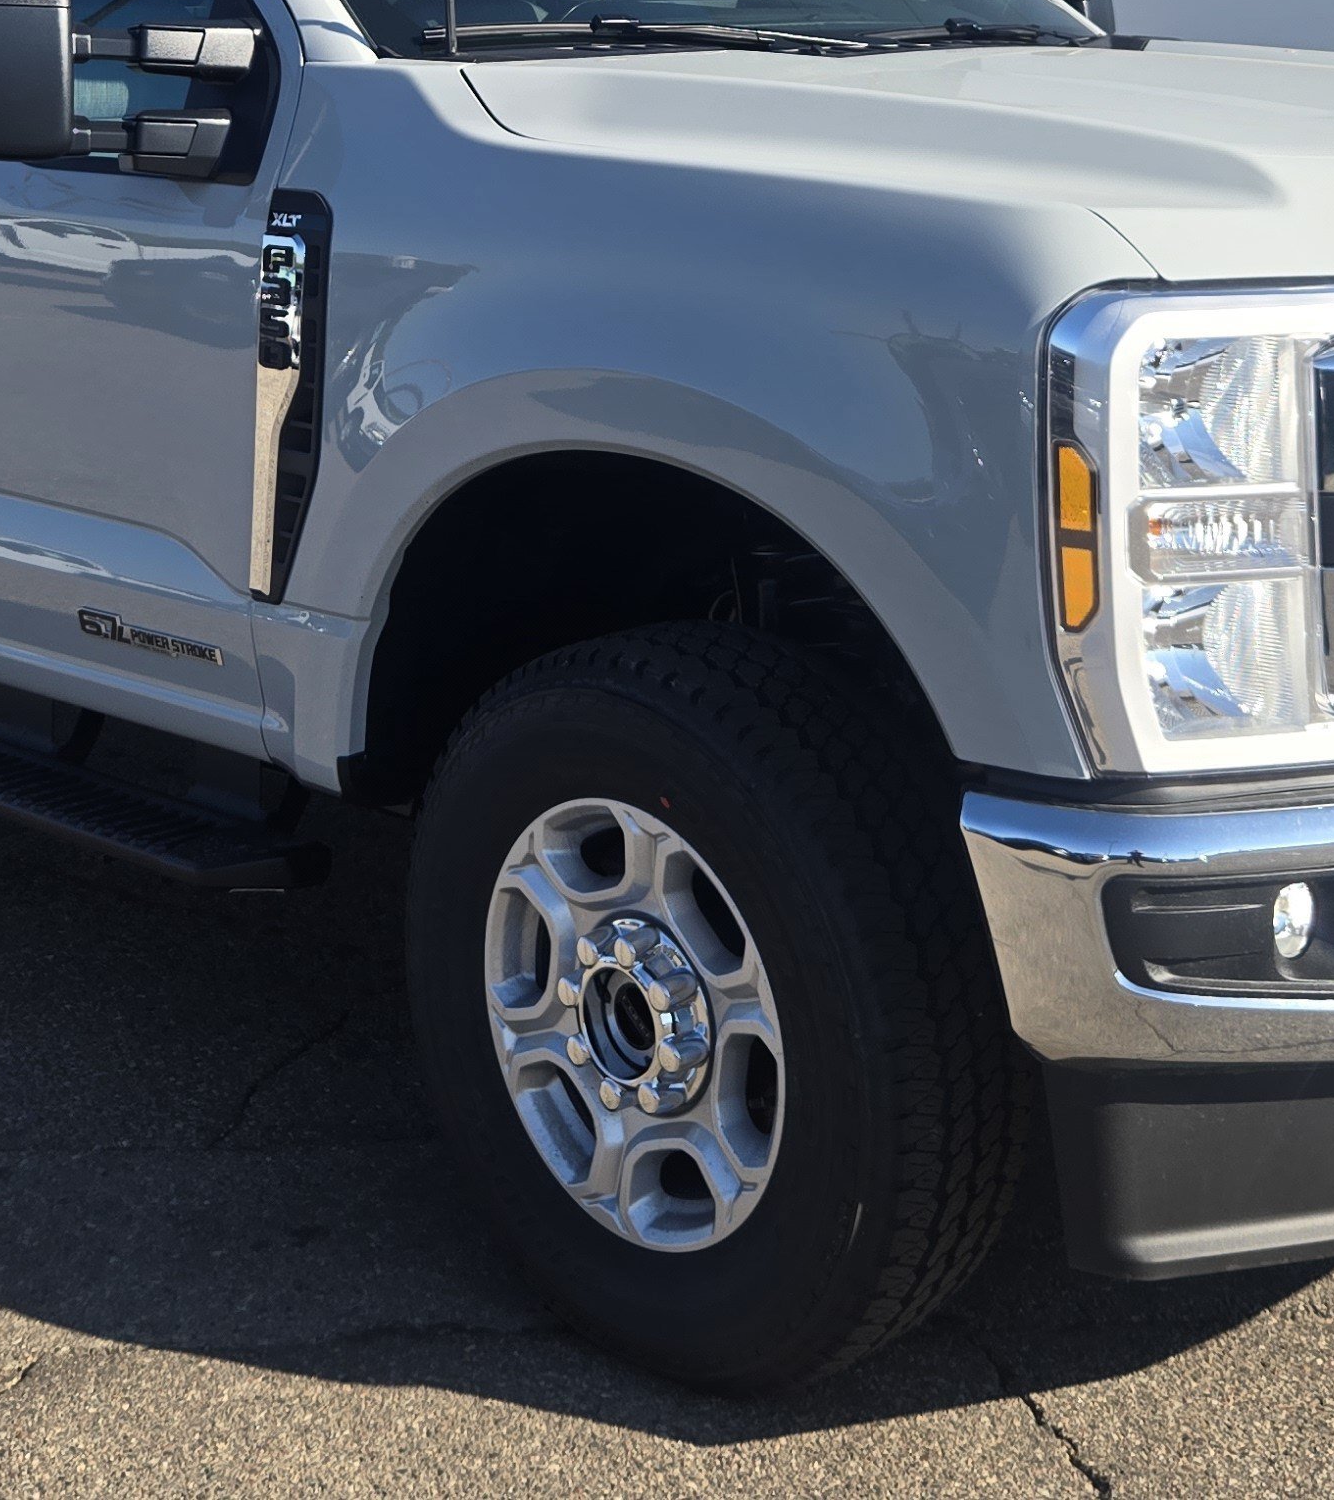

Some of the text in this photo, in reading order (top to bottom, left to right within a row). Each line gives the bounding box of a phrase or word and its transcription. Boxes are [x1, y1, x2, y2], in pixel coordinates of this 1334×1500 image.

[271, 212, 302, 227] XLT
[130, 629, 170, 651] POWER
[170, 638, 218, 663] STROKE
